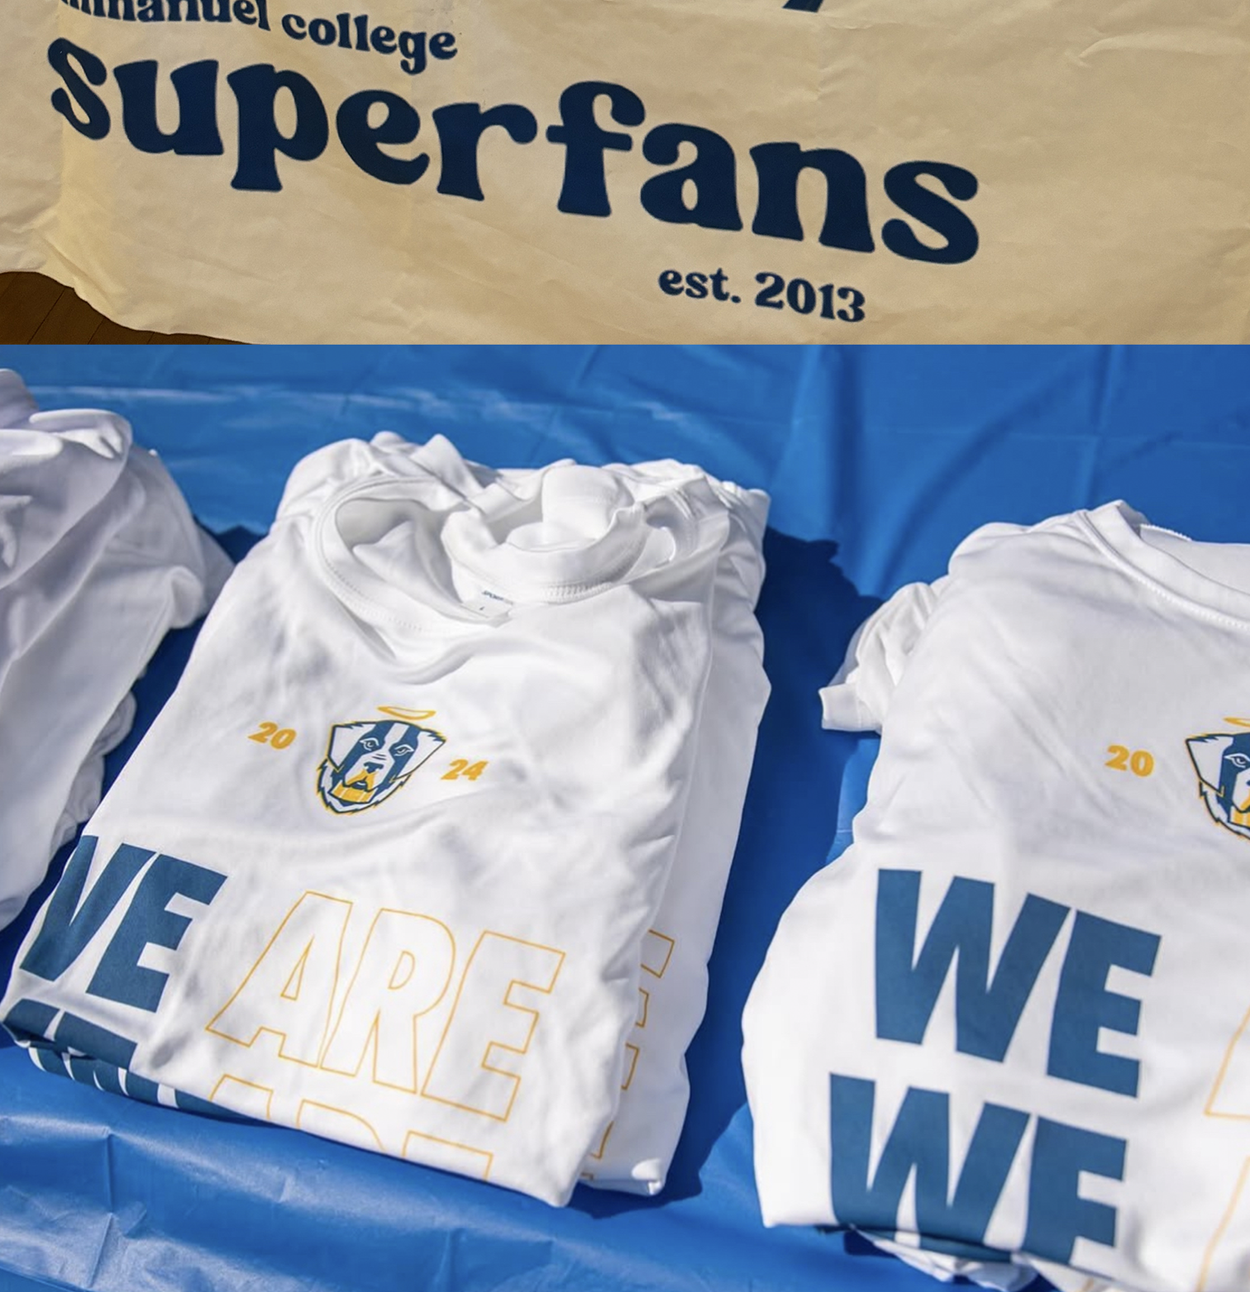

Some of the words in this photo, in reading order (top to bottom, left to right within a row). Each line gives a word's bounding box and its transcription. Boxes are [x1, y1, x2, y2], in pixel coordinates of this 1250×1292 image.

[281, 12, 457, 74] college
[49, 35, 981, 267] superfans
[658, 261, 740, 306] est.
[755, 271, 867, 325] 2013
[249, 721, 297, 750] 20
[441, 759, 488, 783] 24
[1106, 744, 1154, 778] 20
[205, 890, 567, 1123] ARE
[875, 868, 1162, 1099] WE
